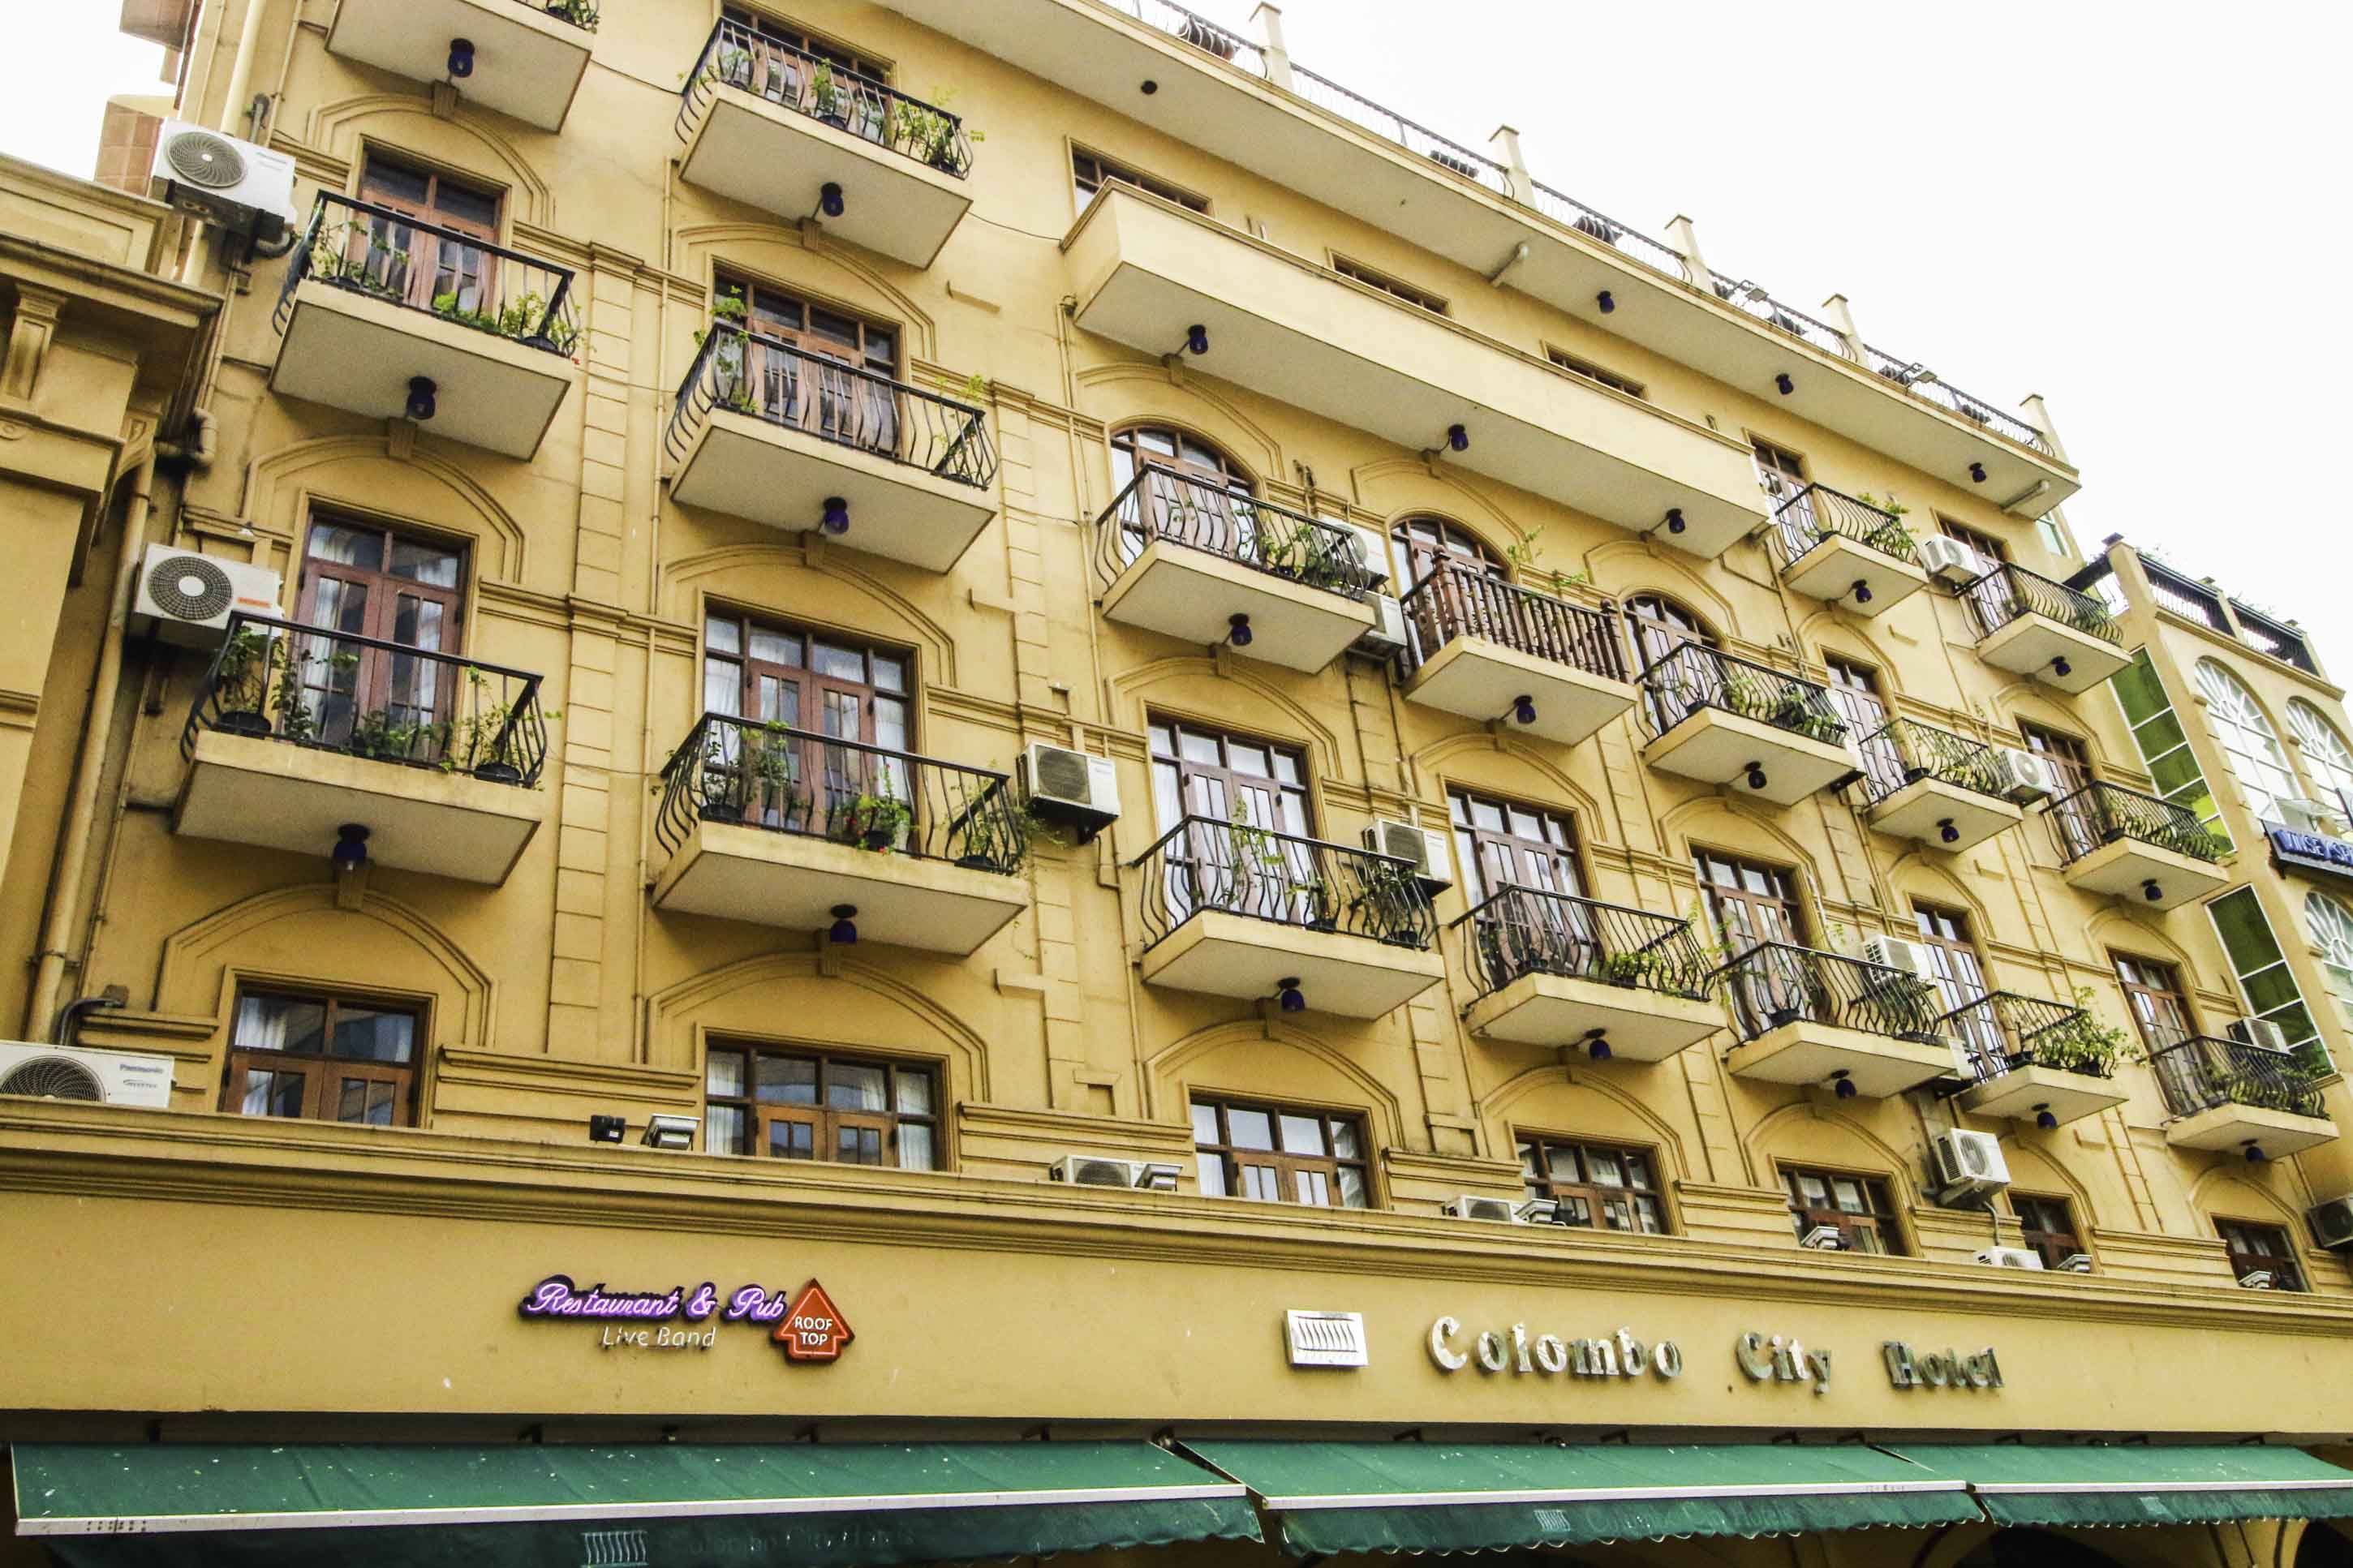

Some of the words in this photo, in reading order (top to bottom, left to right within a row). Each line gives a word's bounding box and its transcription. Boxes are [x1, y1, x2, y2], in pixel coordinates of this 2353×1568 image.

[519, 1274, 684, 1321] Restaurant
[686, 1282, 716, 1321] &
[721, 1284, 787, 1321] Pub
[794, 1316, 833, 1331] ROOF
[602, 1325, 648, 1348] Live
[656, 1326, 716, 1348] Band
[799, 1331, 828, 1347] TOP
[1430, 1316, 1683, 1378] Colombo
[1735, 1331, 1832, 1395] City
